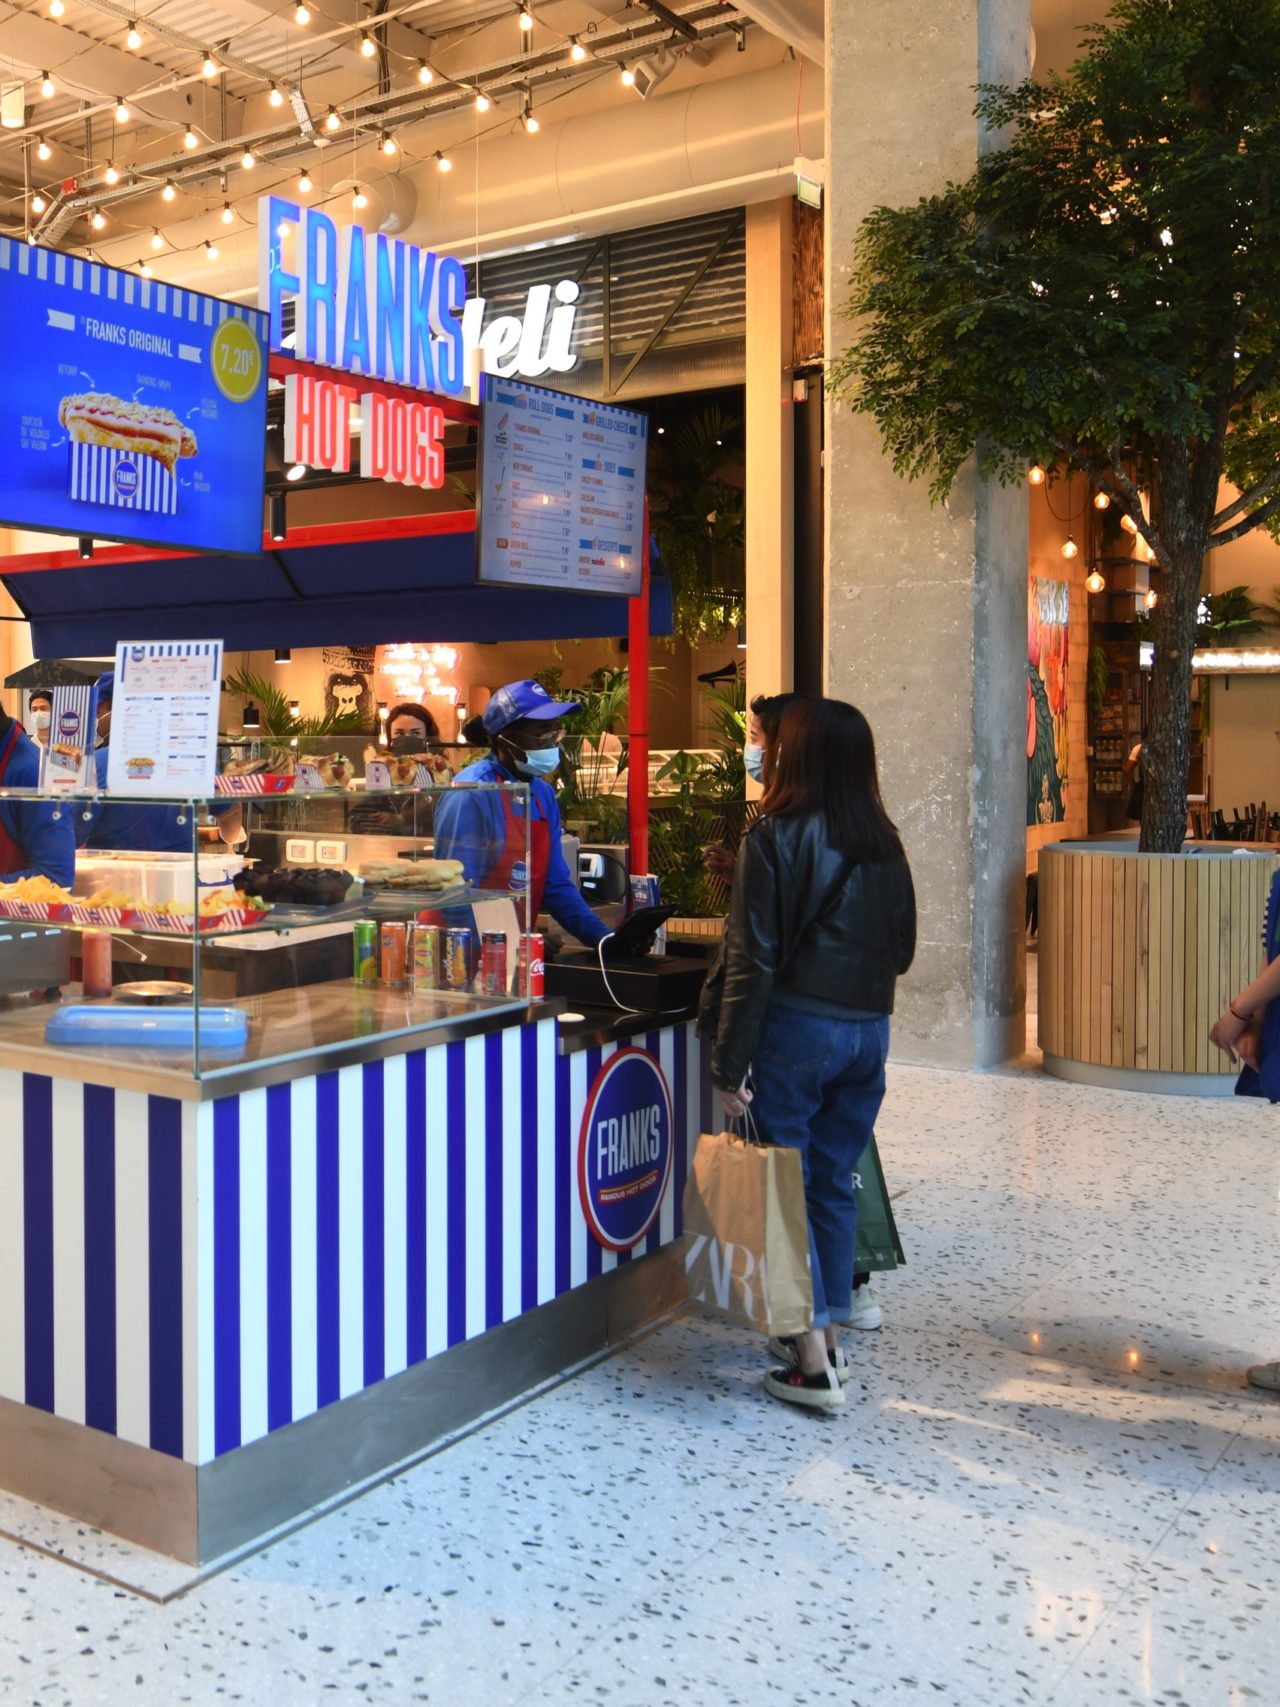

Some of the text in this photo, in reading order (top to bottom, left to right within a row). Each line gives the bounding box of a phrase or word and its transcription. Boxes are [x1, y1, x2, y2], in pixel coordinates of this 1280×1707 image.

[86, 317, 173, 358] FRANKS ORIGINAL
[262, 194, 466, 396] FRANKS
[286, 374, 445, 490] HOT DOGS
[597, 1104, 660, 1180] FRANKS
